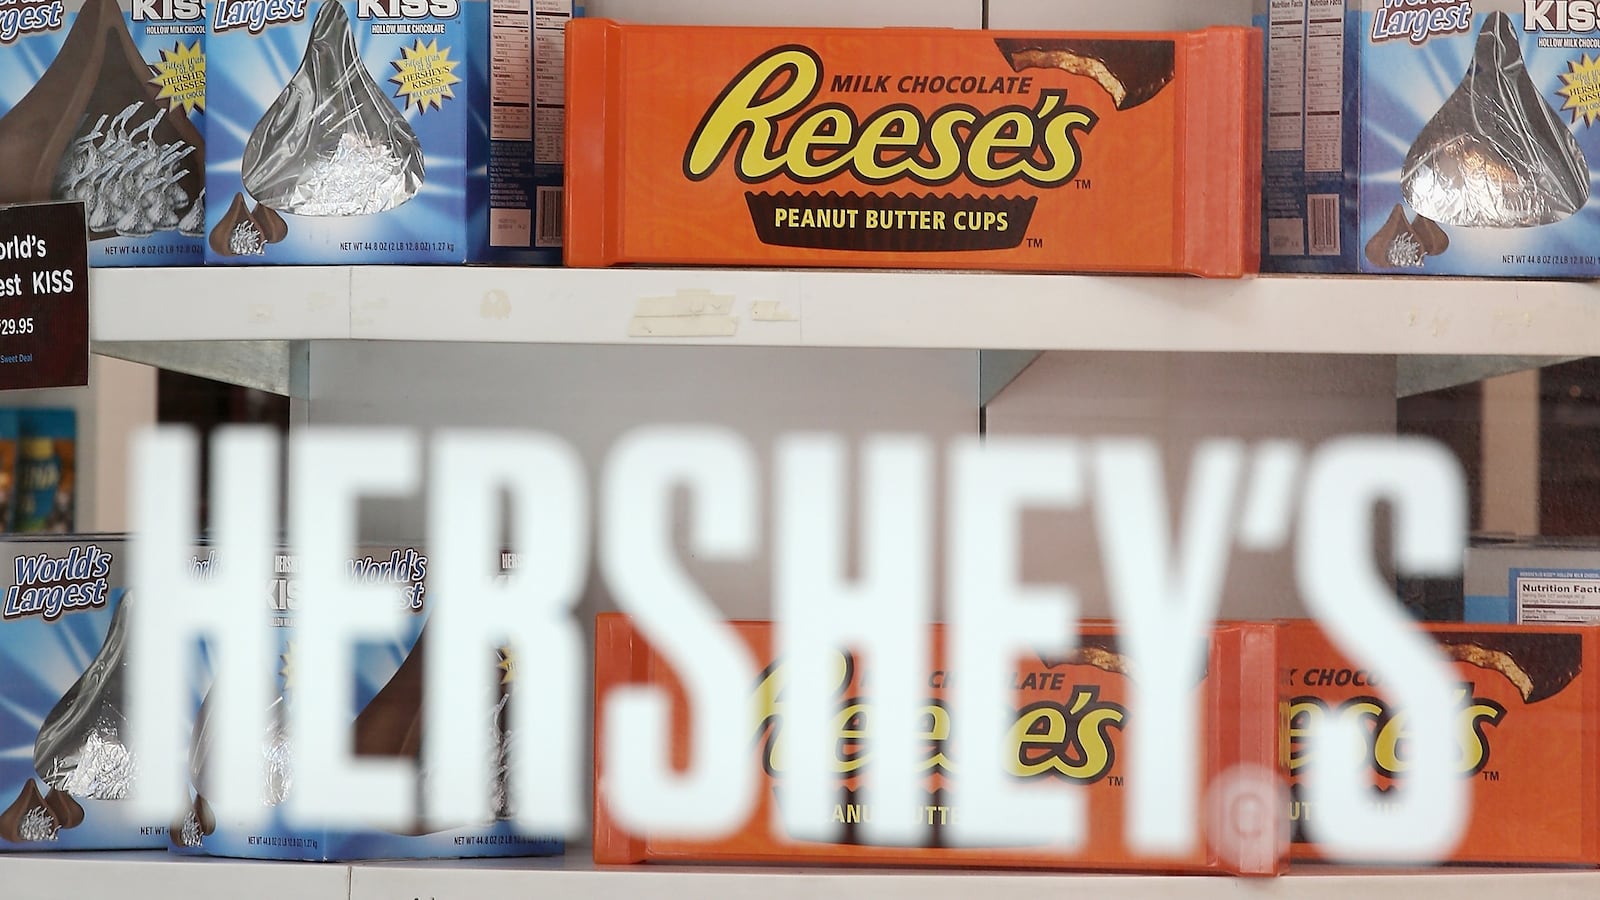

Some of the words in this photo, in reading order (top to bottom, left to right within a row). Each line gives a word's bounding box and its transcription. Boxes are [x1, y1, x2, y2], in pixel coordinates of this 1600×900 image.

[132, 0, 206, 20] KIS
[214, 0, 304, 32] Largest
[357, 0, 458, 18] KISS
[1524, 0, 1600, 31] KIS
[412, 24, 445, 33] CHOCOLATE
[1372, 2, 1471, 42] Largest
[830, 75, 890, 93] MILK
[897, 76, 1034, 95] CHOCOLATE
[685, 46, 1099, 187] Reese's
[1075, 179, 1091, 189] TM
[774, 208, 858, 229] PEANUT
[865, 209, 947, 230] BUTTER
[953, 211, 1009, 231] CUPS
[105, 246, 117, 255] NET
[120, 246, 129, 254] WT
[340, 242, 351, 251] NET
[353, 242, 363, 251] WT
[364, 242, 378, 251] 44.8
[379, 242, 387, 251] OZ
[1026, 238, 1043, 248] TM
[1502, 255, 1514, 264] NET
[1516, 255, 1526, 264] WT
[33, 269, 74, 295] KISS
[0, 318, 34, 335] 29.95
[15, 545, 112, 585] World's
[346, 548, 428, 586] World's
[1522, 584, 1570, 592] Nutrition
[4, 578, 107, 618] Largest
[128, 424, 1470, 868] HERSHEY'S
[1107, 776, 1124, 787] TM
[1482, 771, 1499, 781] TM
[140, 826, 153, 835] NET
[154, 826, 165, 835] WT
[454, 836, 464, 845] NET
[466, 836, 475, 845] WT
